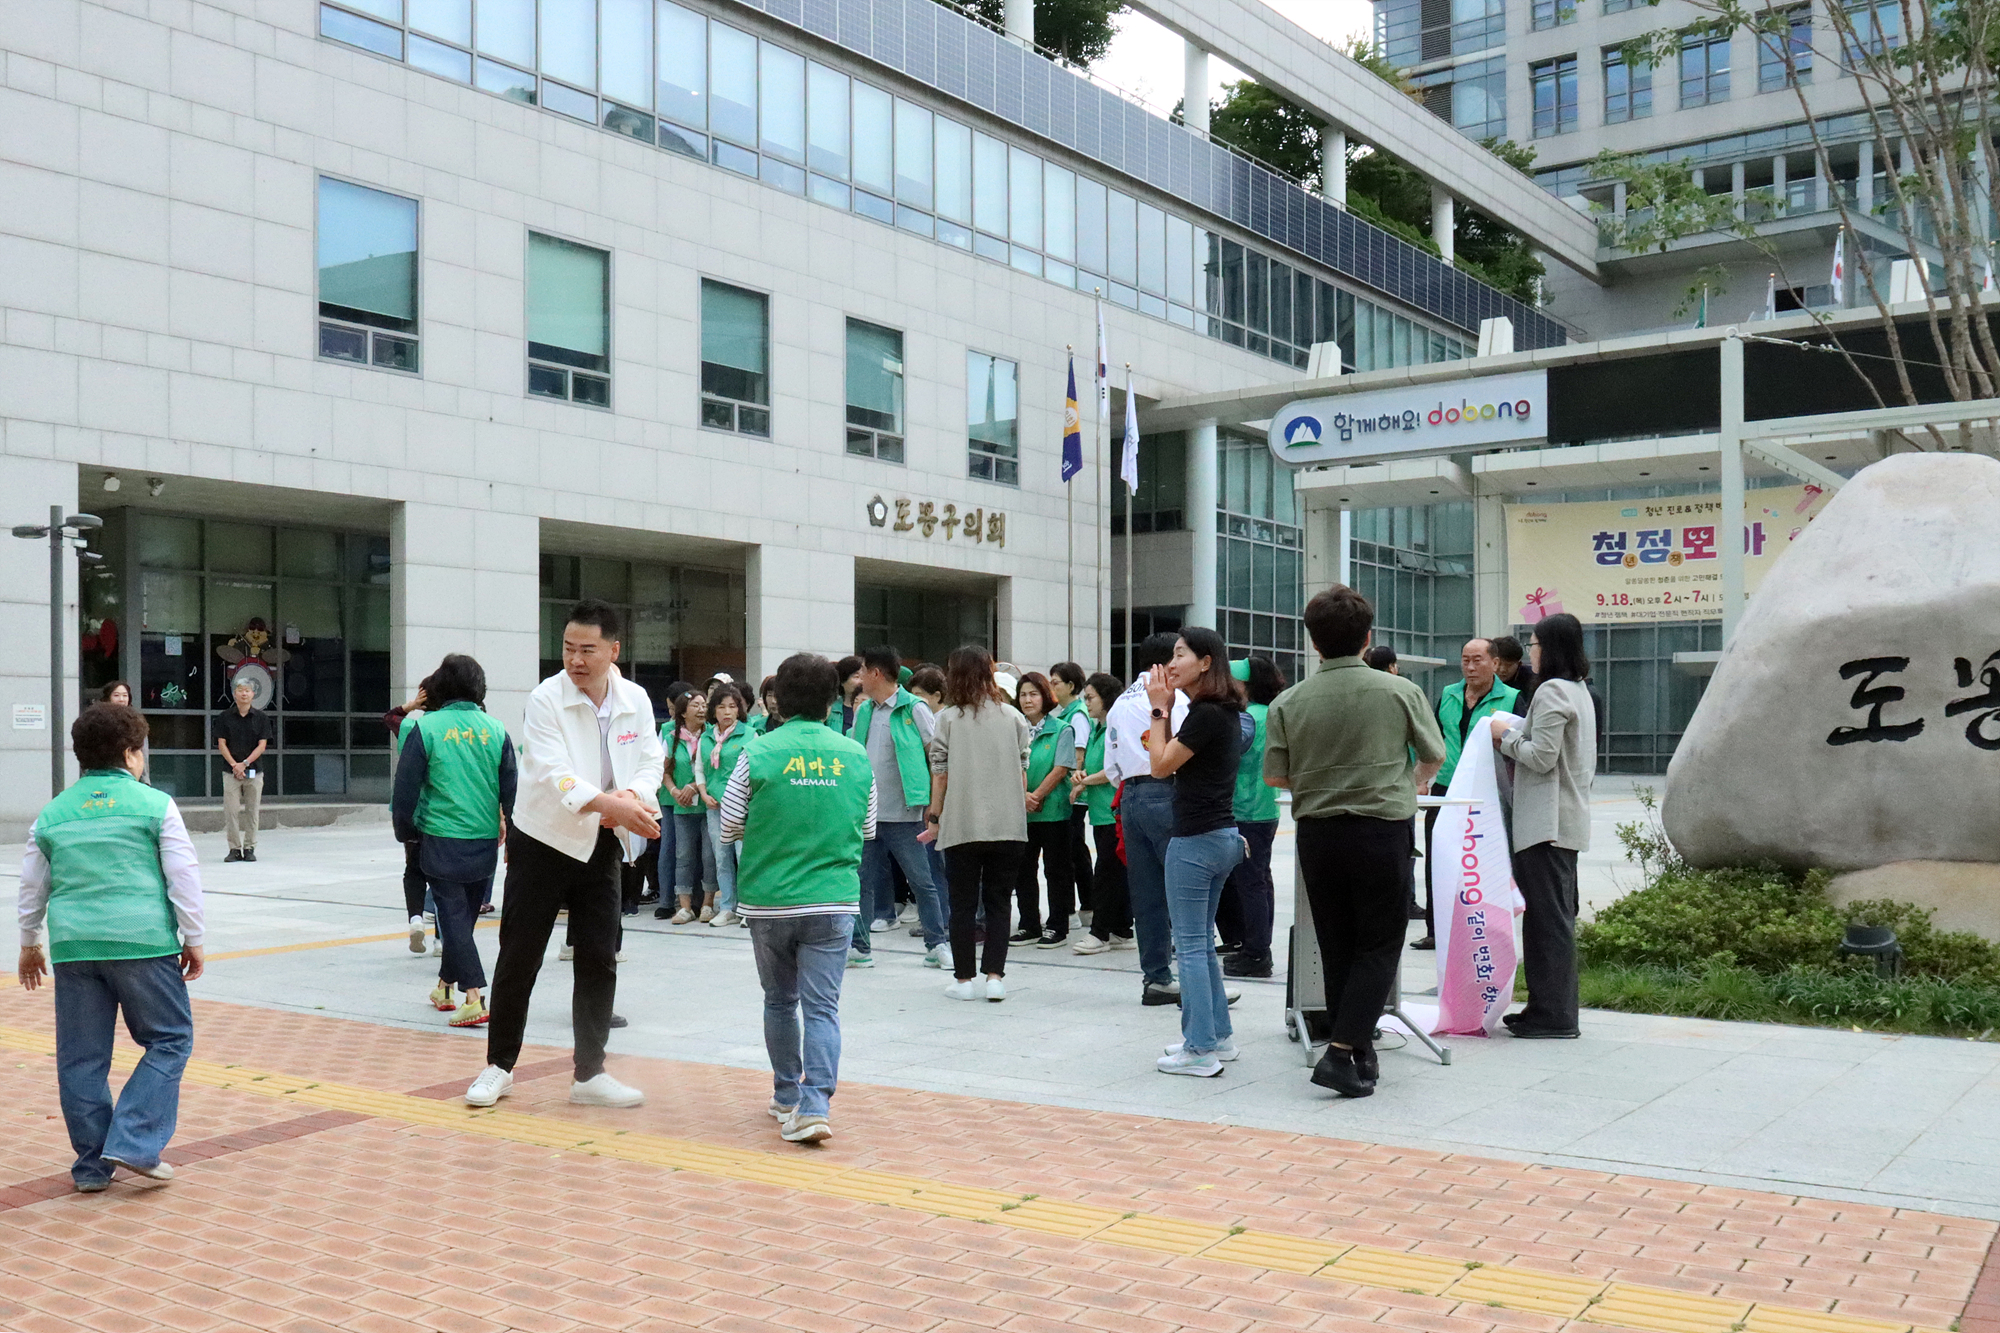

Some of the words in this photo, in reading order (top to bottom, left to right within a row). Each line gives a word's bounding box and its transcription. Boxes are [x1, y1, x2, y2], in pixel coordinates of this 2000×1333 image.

[1333, 410, 1421, 442] 함께해요!
[1427, 398, 1531, 426] dobong
[893, 498, 1006, 548] 도봉구의회
[1645, 506, 1663, 517] 청년
[443, 726, 491, 746] 새마을
[782, 755, 845, 778] 새마을
[790, 778, 838, 787] SAEMAUL
[1467, 911, 1485, 940] 같이
